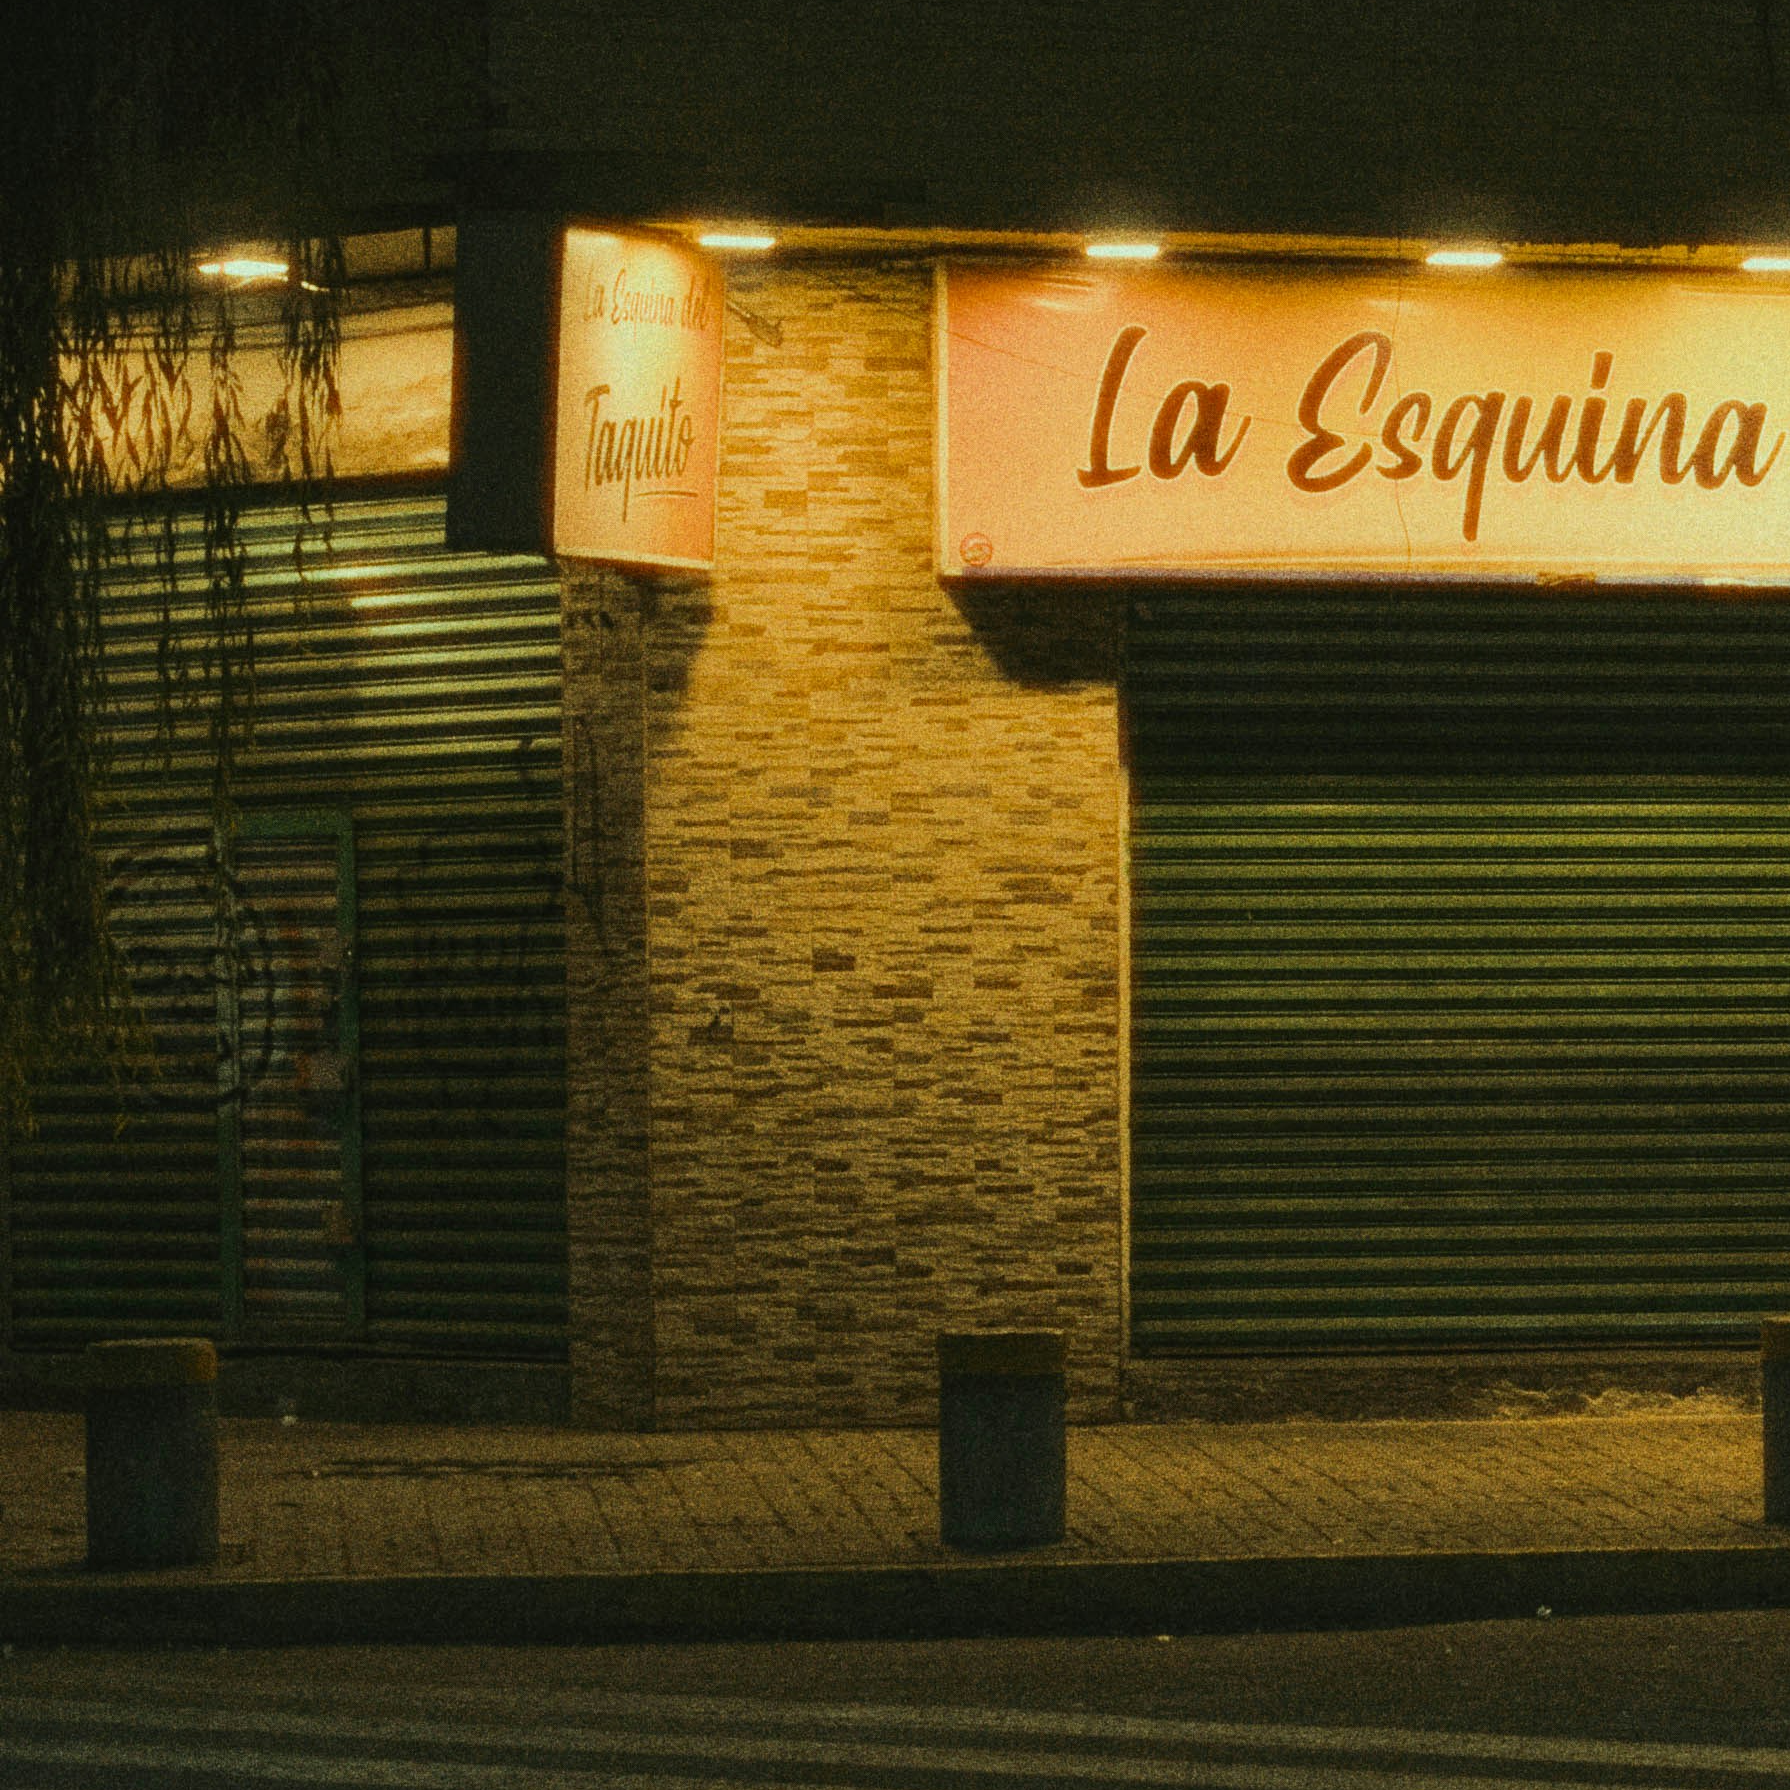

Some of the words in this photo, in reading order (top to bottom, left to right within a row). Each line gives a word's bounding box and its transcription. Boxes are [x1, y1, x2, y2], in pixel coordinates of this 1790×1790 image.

[610, 267, 675, 342] Esquina
[680, 274, 711, 331] del
[585, 375, 696, 524] Taquito
[1077, 324, 1251, 491] La
[1284, 331, 1785, 540] Esquina
